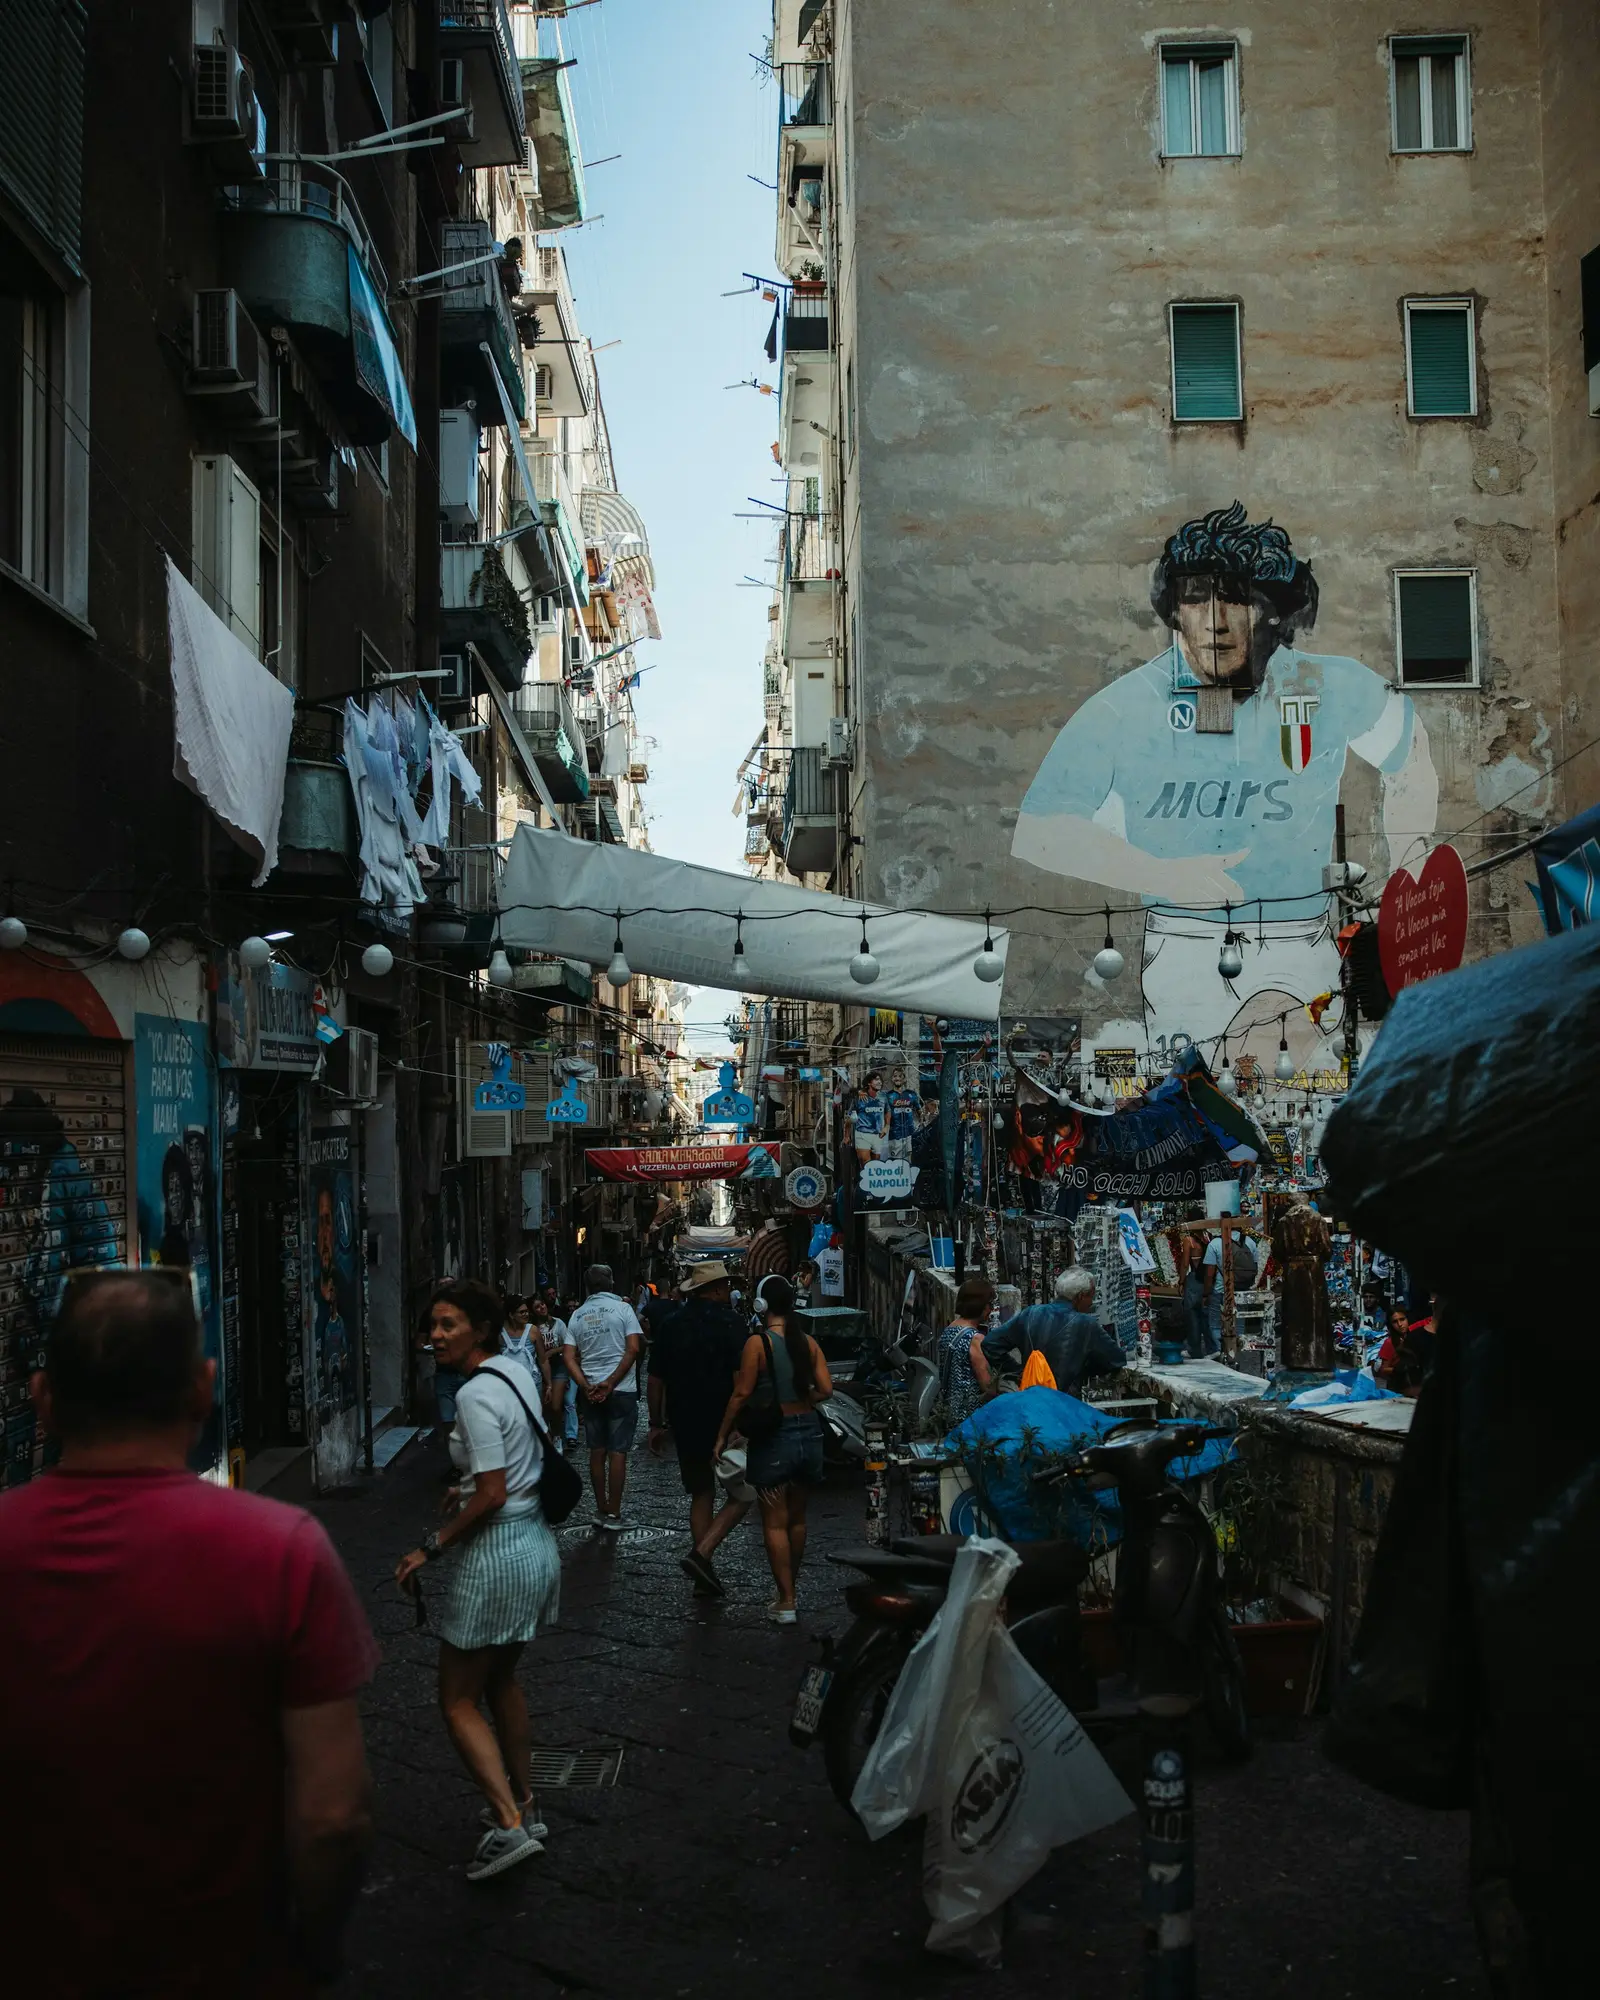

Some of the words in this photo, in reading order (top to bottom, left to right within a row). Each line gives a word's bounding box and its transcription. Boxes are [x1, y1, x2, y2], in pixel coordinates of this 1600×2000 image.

[1173, 706, 1190, 728] N
[1144, 779, 1294, 821] Mars
[1406, 888, 1427, 912] Vocca
[1408, 916, 1430, 936] Vocca
[1432, 905, 1447, 924] mia
[1398, 948, 1419, 967] senza
[1432, 930, 1447, 954] Vas
[164, 1032, 193, 1064] JUEGO
[151, 1067, 172, 1097] PARA
[175, 1069, 195, 1104] VOS,
[626, 1164, 638, 1172] LA
[639, 1164, 676, 1172] PIZZERIA
[692, 1161, 738, 1170] QUARTIERI
[868, 1167, 893, 1177] L'Oro
[895, 1166, 904, 1176] di
[1060, 1163, 1089, 1189] HO
[1094, 1172, 1150, 1195] OCCHI
[1150, 1169, 1197, 1196] SOLO
[869, 1178, 909, 1189] NAPOLI!
